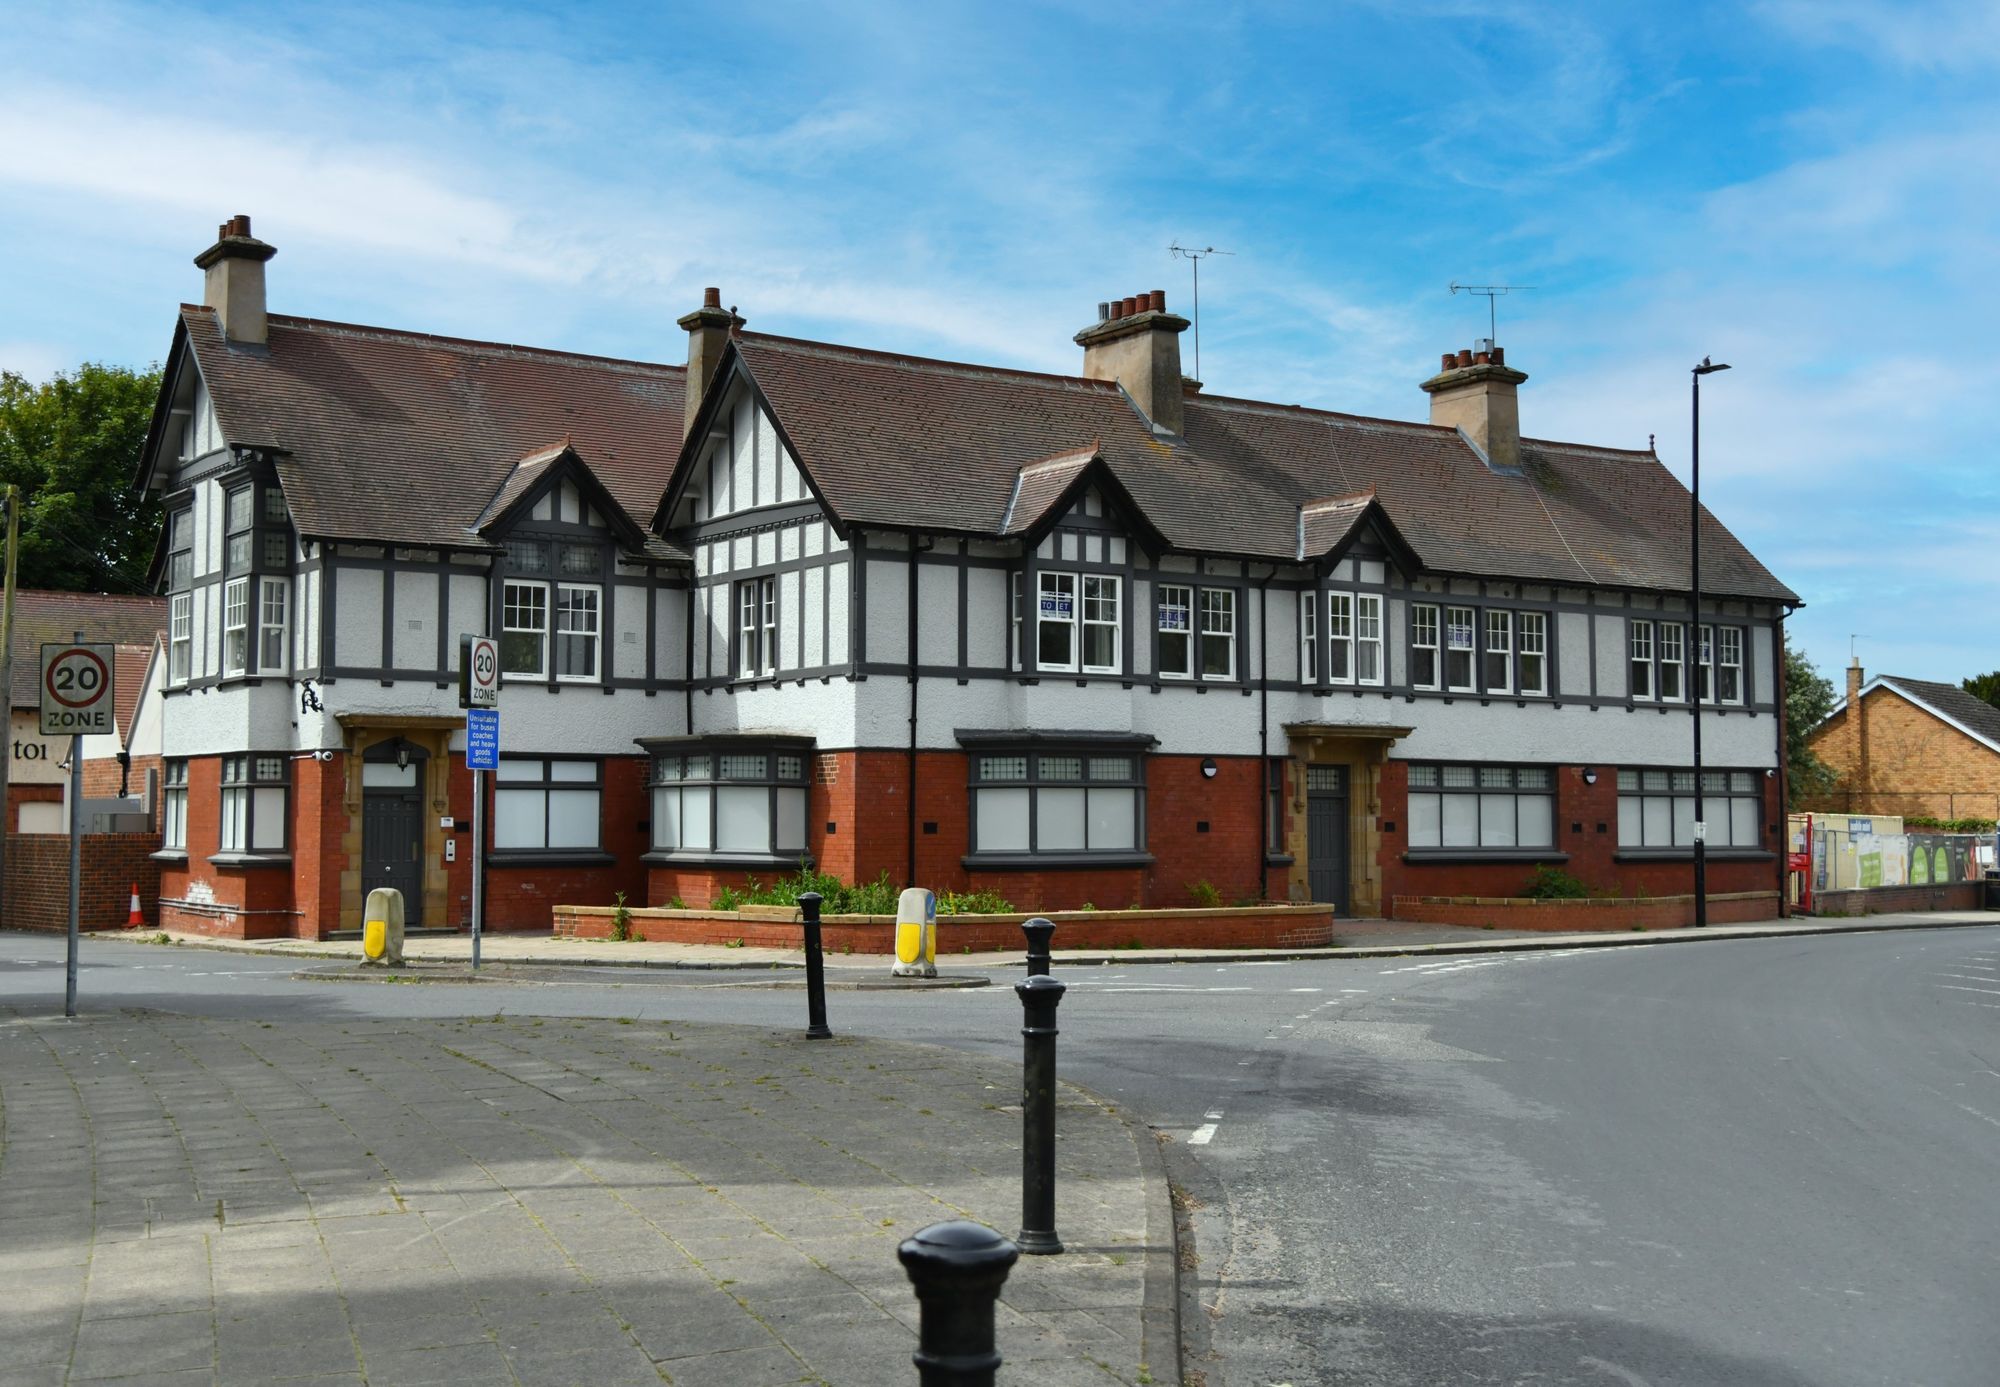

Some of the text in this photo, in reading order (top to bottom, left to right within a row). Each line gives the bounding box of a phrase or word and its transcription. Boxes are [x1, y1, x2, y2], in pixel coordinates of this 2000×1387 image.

[1042, 601, 1052, 610] TO
[477, 654, 493, 673] 20
[56, 666, 99, 690] 20
[474, 687, 495, 701] ZONE
[48, 711, 105, 727] ZONE
[481, 741, 496, 749] heavy
[472, 757, 493, 765] vehicles
